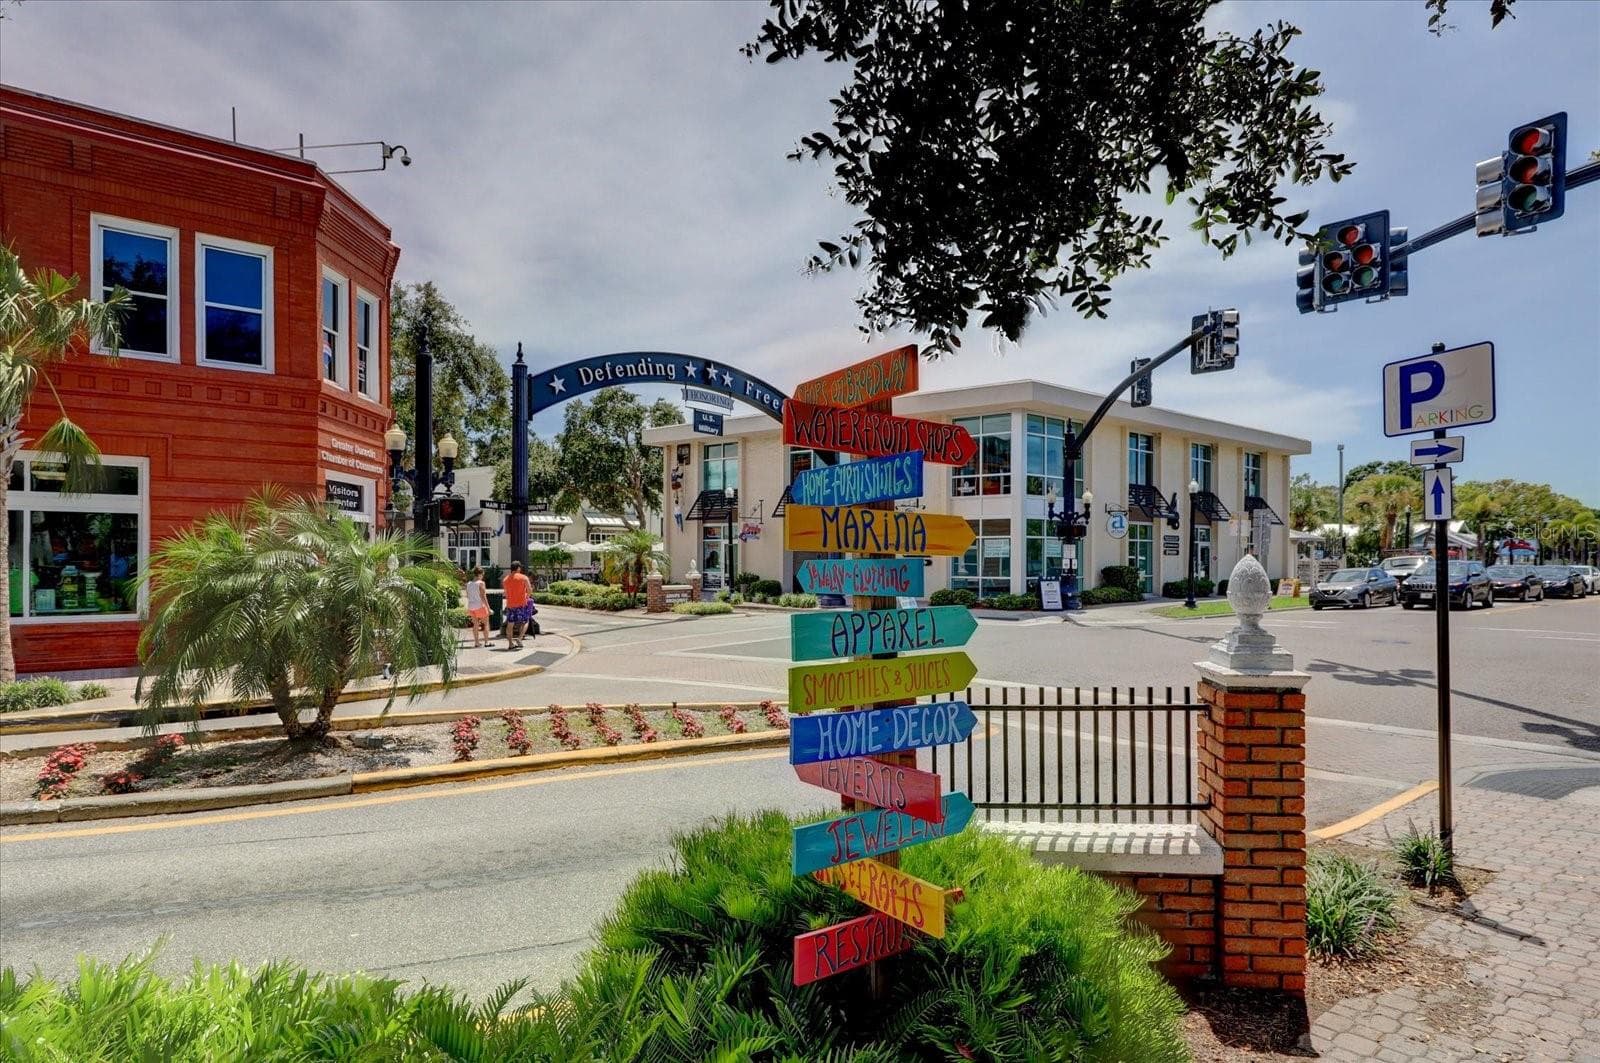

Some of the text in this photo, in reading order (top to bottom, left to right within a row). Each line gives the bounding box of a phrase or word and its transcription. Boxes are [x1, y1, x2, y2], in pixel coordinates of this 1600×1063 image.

[578, 357, 784, 415] Defending Free
[915, 420, 963, 462] SHOPS
[328, 484, 359, 497] Visitors
[801, 468, 831, 506] HOME
[831, 608, 945, 657] APPAREL
[803, 664, 890, 706] SMOOTHIES
[904, 658, 951, 693] JUICES
[818, 703, 963, 760] HOME DECOR
[856, 860, 925, 928] CRAFTS
[814, 914, 904, 978] RESTAU
